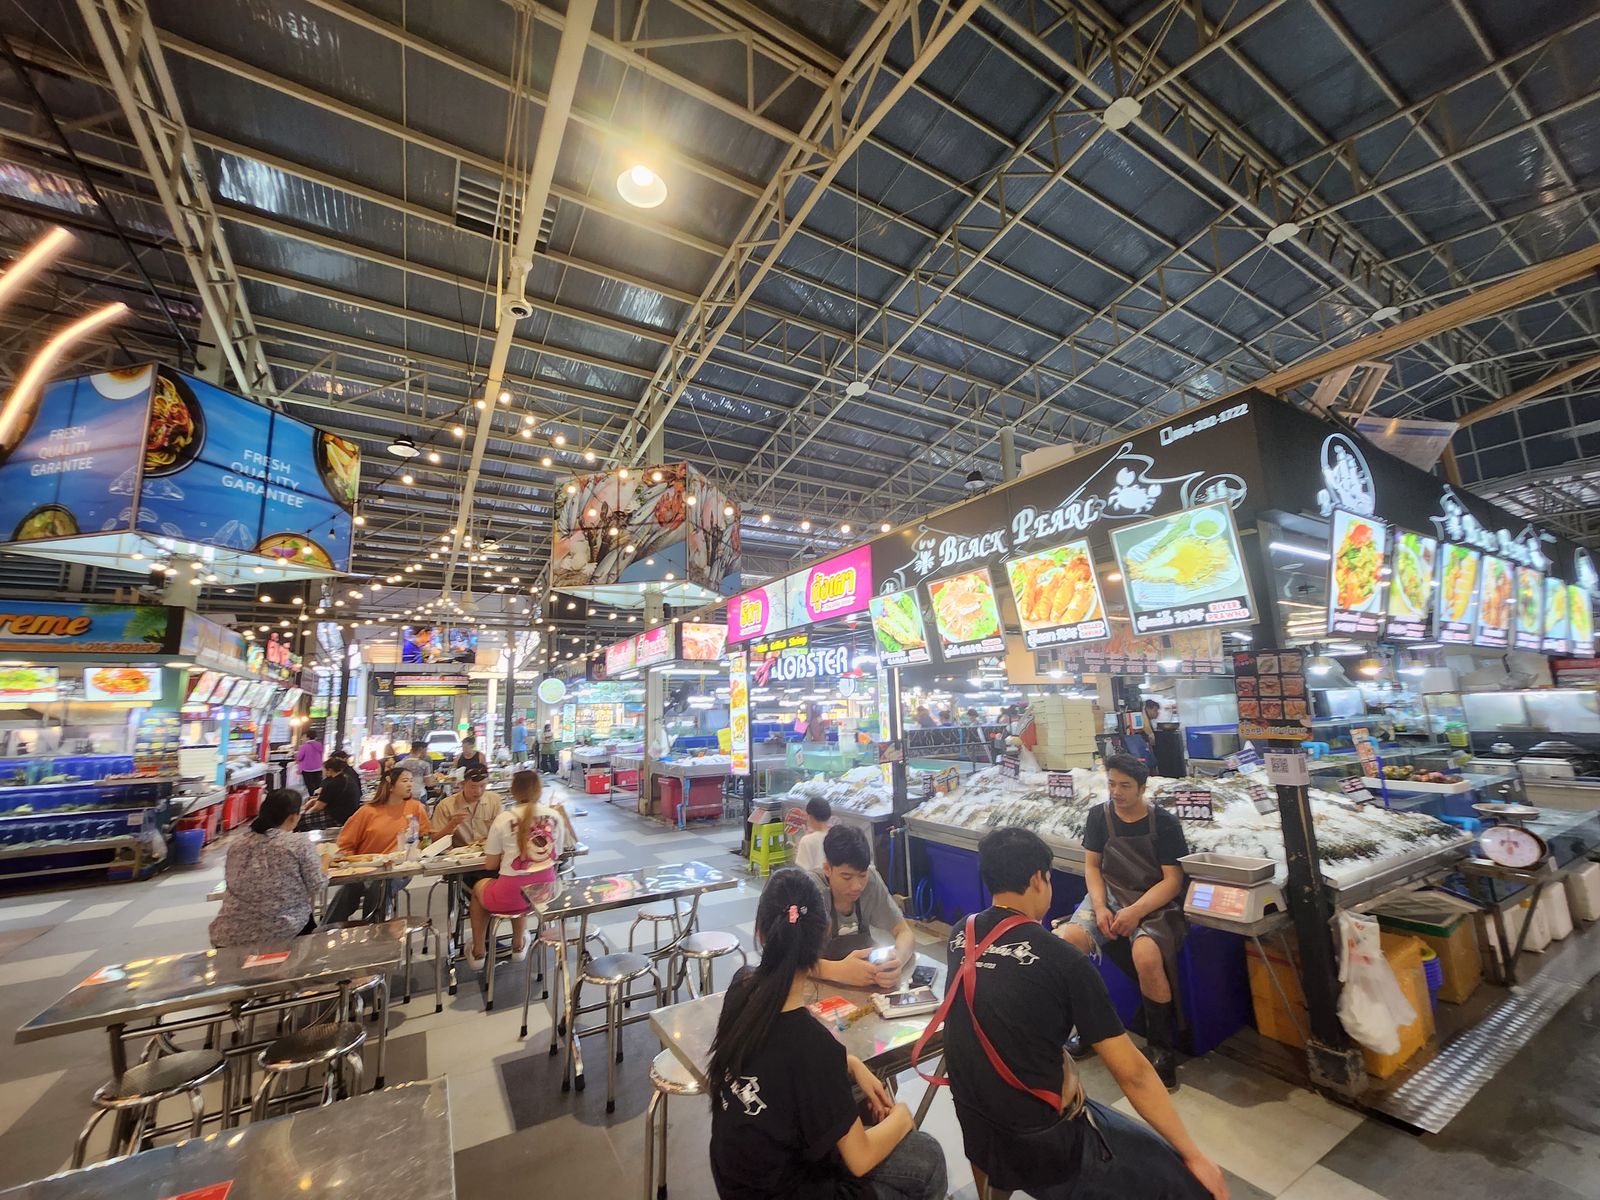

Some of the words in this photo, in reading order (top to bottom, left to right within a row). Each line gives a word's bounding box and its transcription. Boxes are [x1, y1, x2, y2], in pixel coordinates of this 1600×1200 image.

[49, 426, 87, 441] FRESH
[39, 442, 92, 459] QUALITY
[243, 449, 291, 474] FRESH
[31, 457, 94, 476] GARANTEE
[231, 461, 299, 490] QUALITY
[222, 475, 304, 508] GARANTEE
[939, 529, 1008, 567] BLACK
[1012, 499, 1099, 545] PEARL
[1207, 610, 1248, 620] PRAWNS
[1211, 601, 1239, 611] RIVER
[777, 646, 848, 681] LOBSTER
